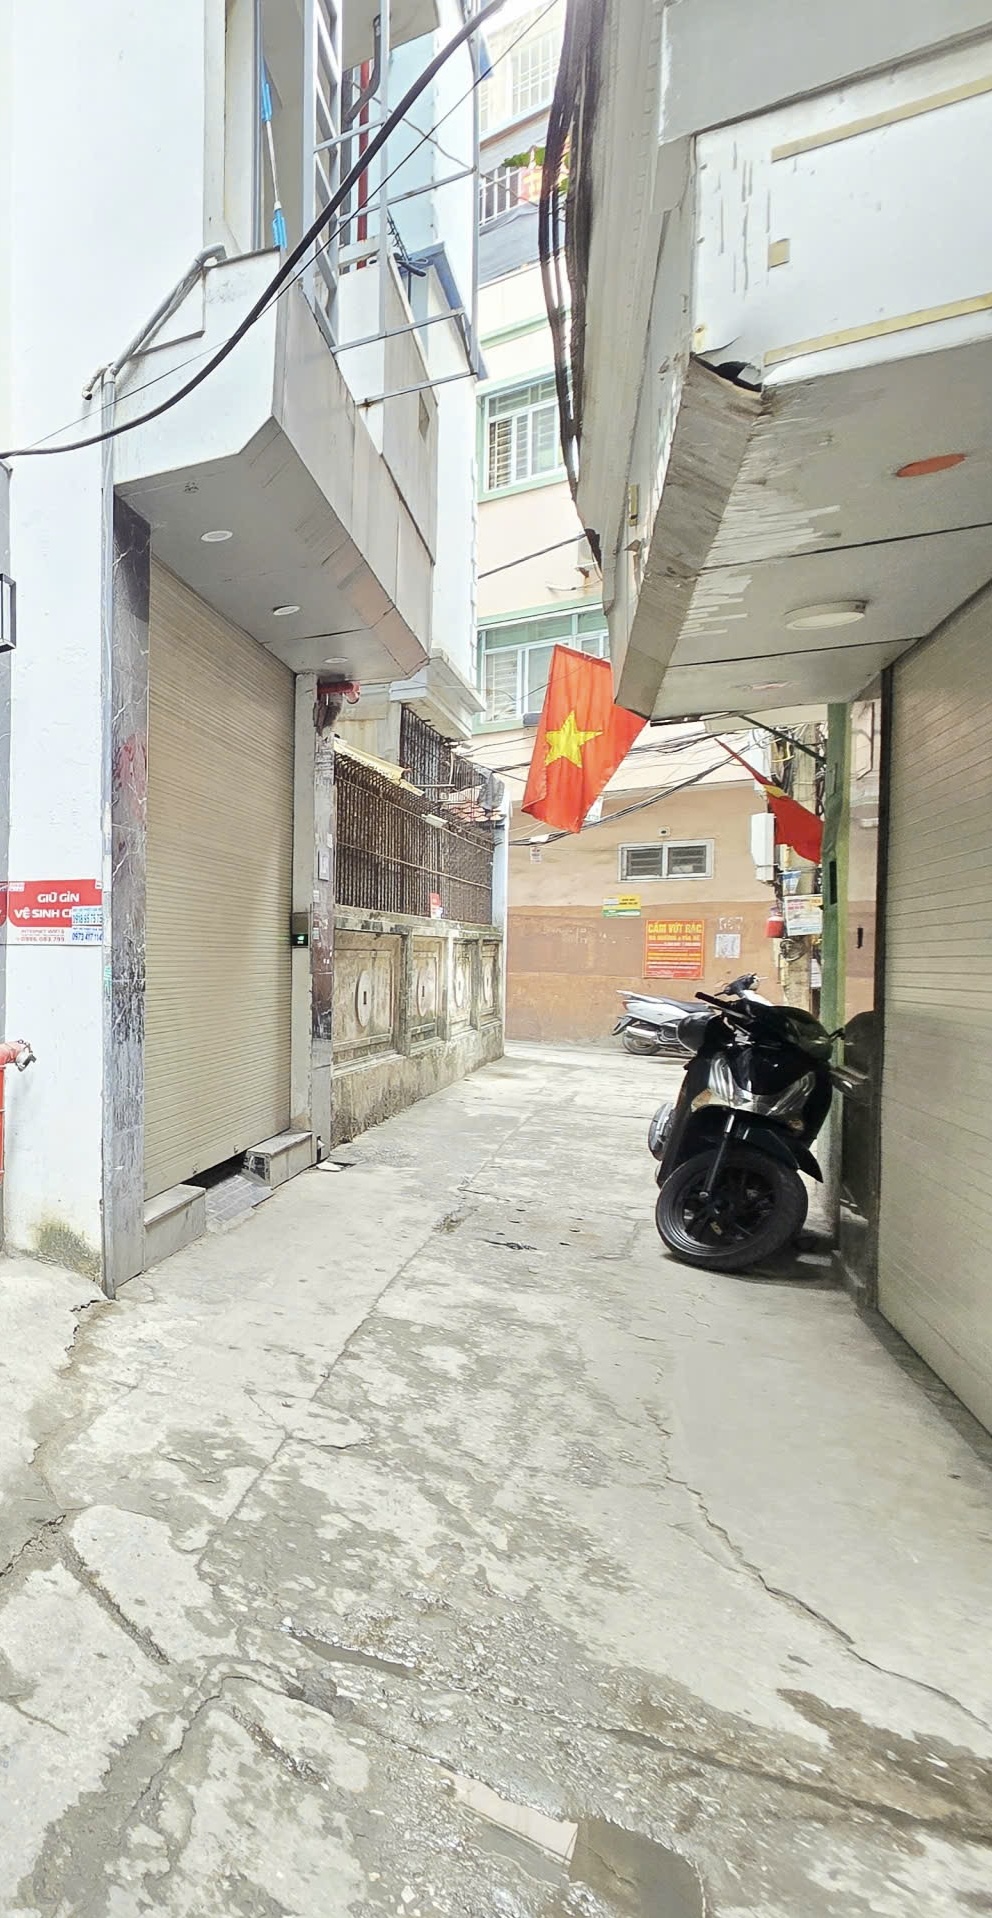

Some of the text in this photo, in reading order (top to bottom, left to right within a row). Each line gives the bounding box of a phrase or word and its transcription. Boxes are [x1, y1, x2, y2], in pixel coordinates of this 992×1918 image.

[59, 890, 80, 903] GÌN
[13, 906, 31, 919] VỆ
[32, 908, 60, 918] SINH
